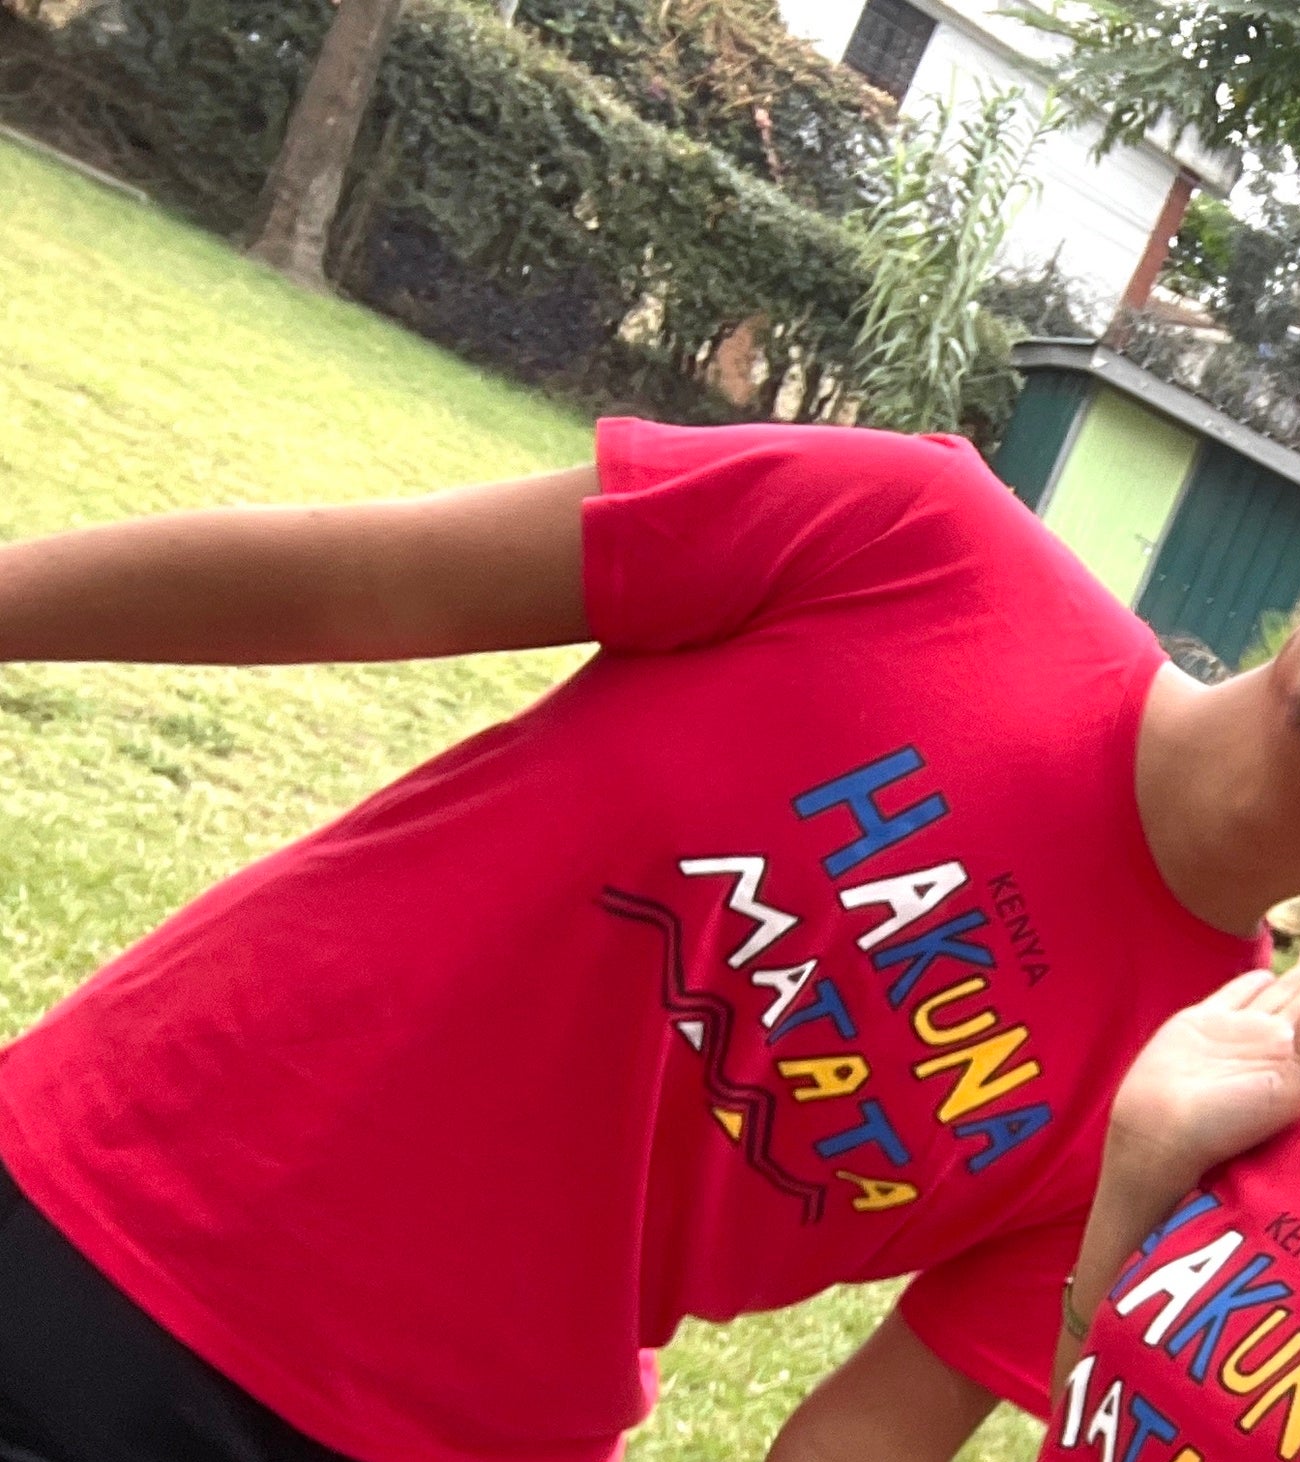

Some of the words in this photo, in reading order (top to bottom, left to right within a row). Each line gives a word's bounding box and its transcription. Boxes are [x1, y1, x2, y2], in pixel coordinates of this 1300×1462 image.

[677, 854, 919, 1211] MATATA
[792, 744, 1053, 1175] HAKUNA
[986, 869, 1052, 988] KENYA
